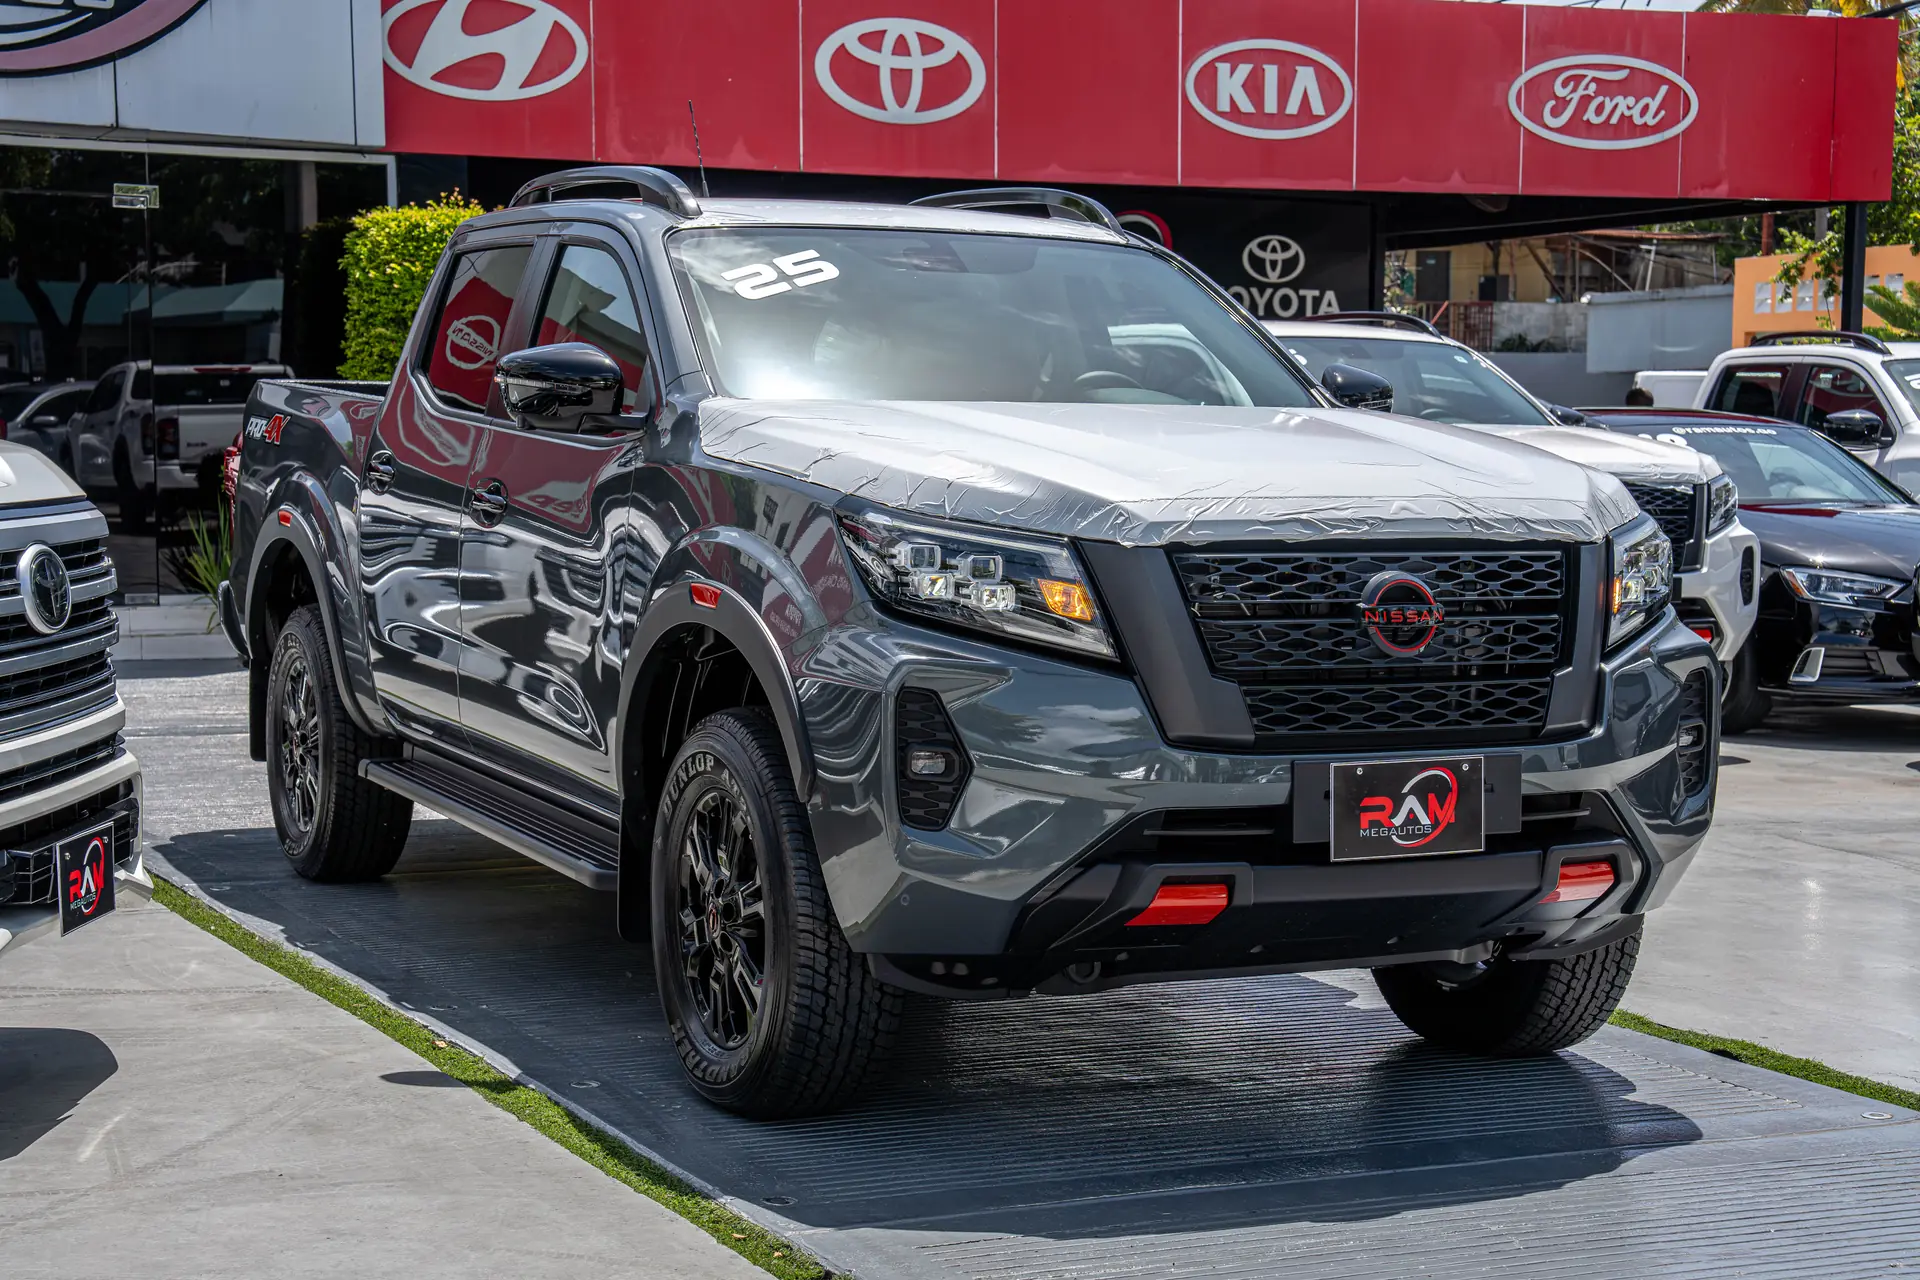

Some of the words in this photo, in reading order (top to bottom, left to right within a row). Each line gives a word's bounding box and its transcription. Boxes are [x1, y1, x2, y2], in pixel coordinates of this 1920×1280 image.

[1214, 62, 1326, 116] KIA
[1543, 68, 1669, 128] Ford
[720, 249, 840, 300] 25
[1222, 285, 1340, 318] OYOTA
[1364, 609, 1443, 623] NISSAN
[1359, 793, 1456, 830] RAM
[1360, 824, 1432, 838] MEGAUTOS
[69, 861, 104, 903] RAM
